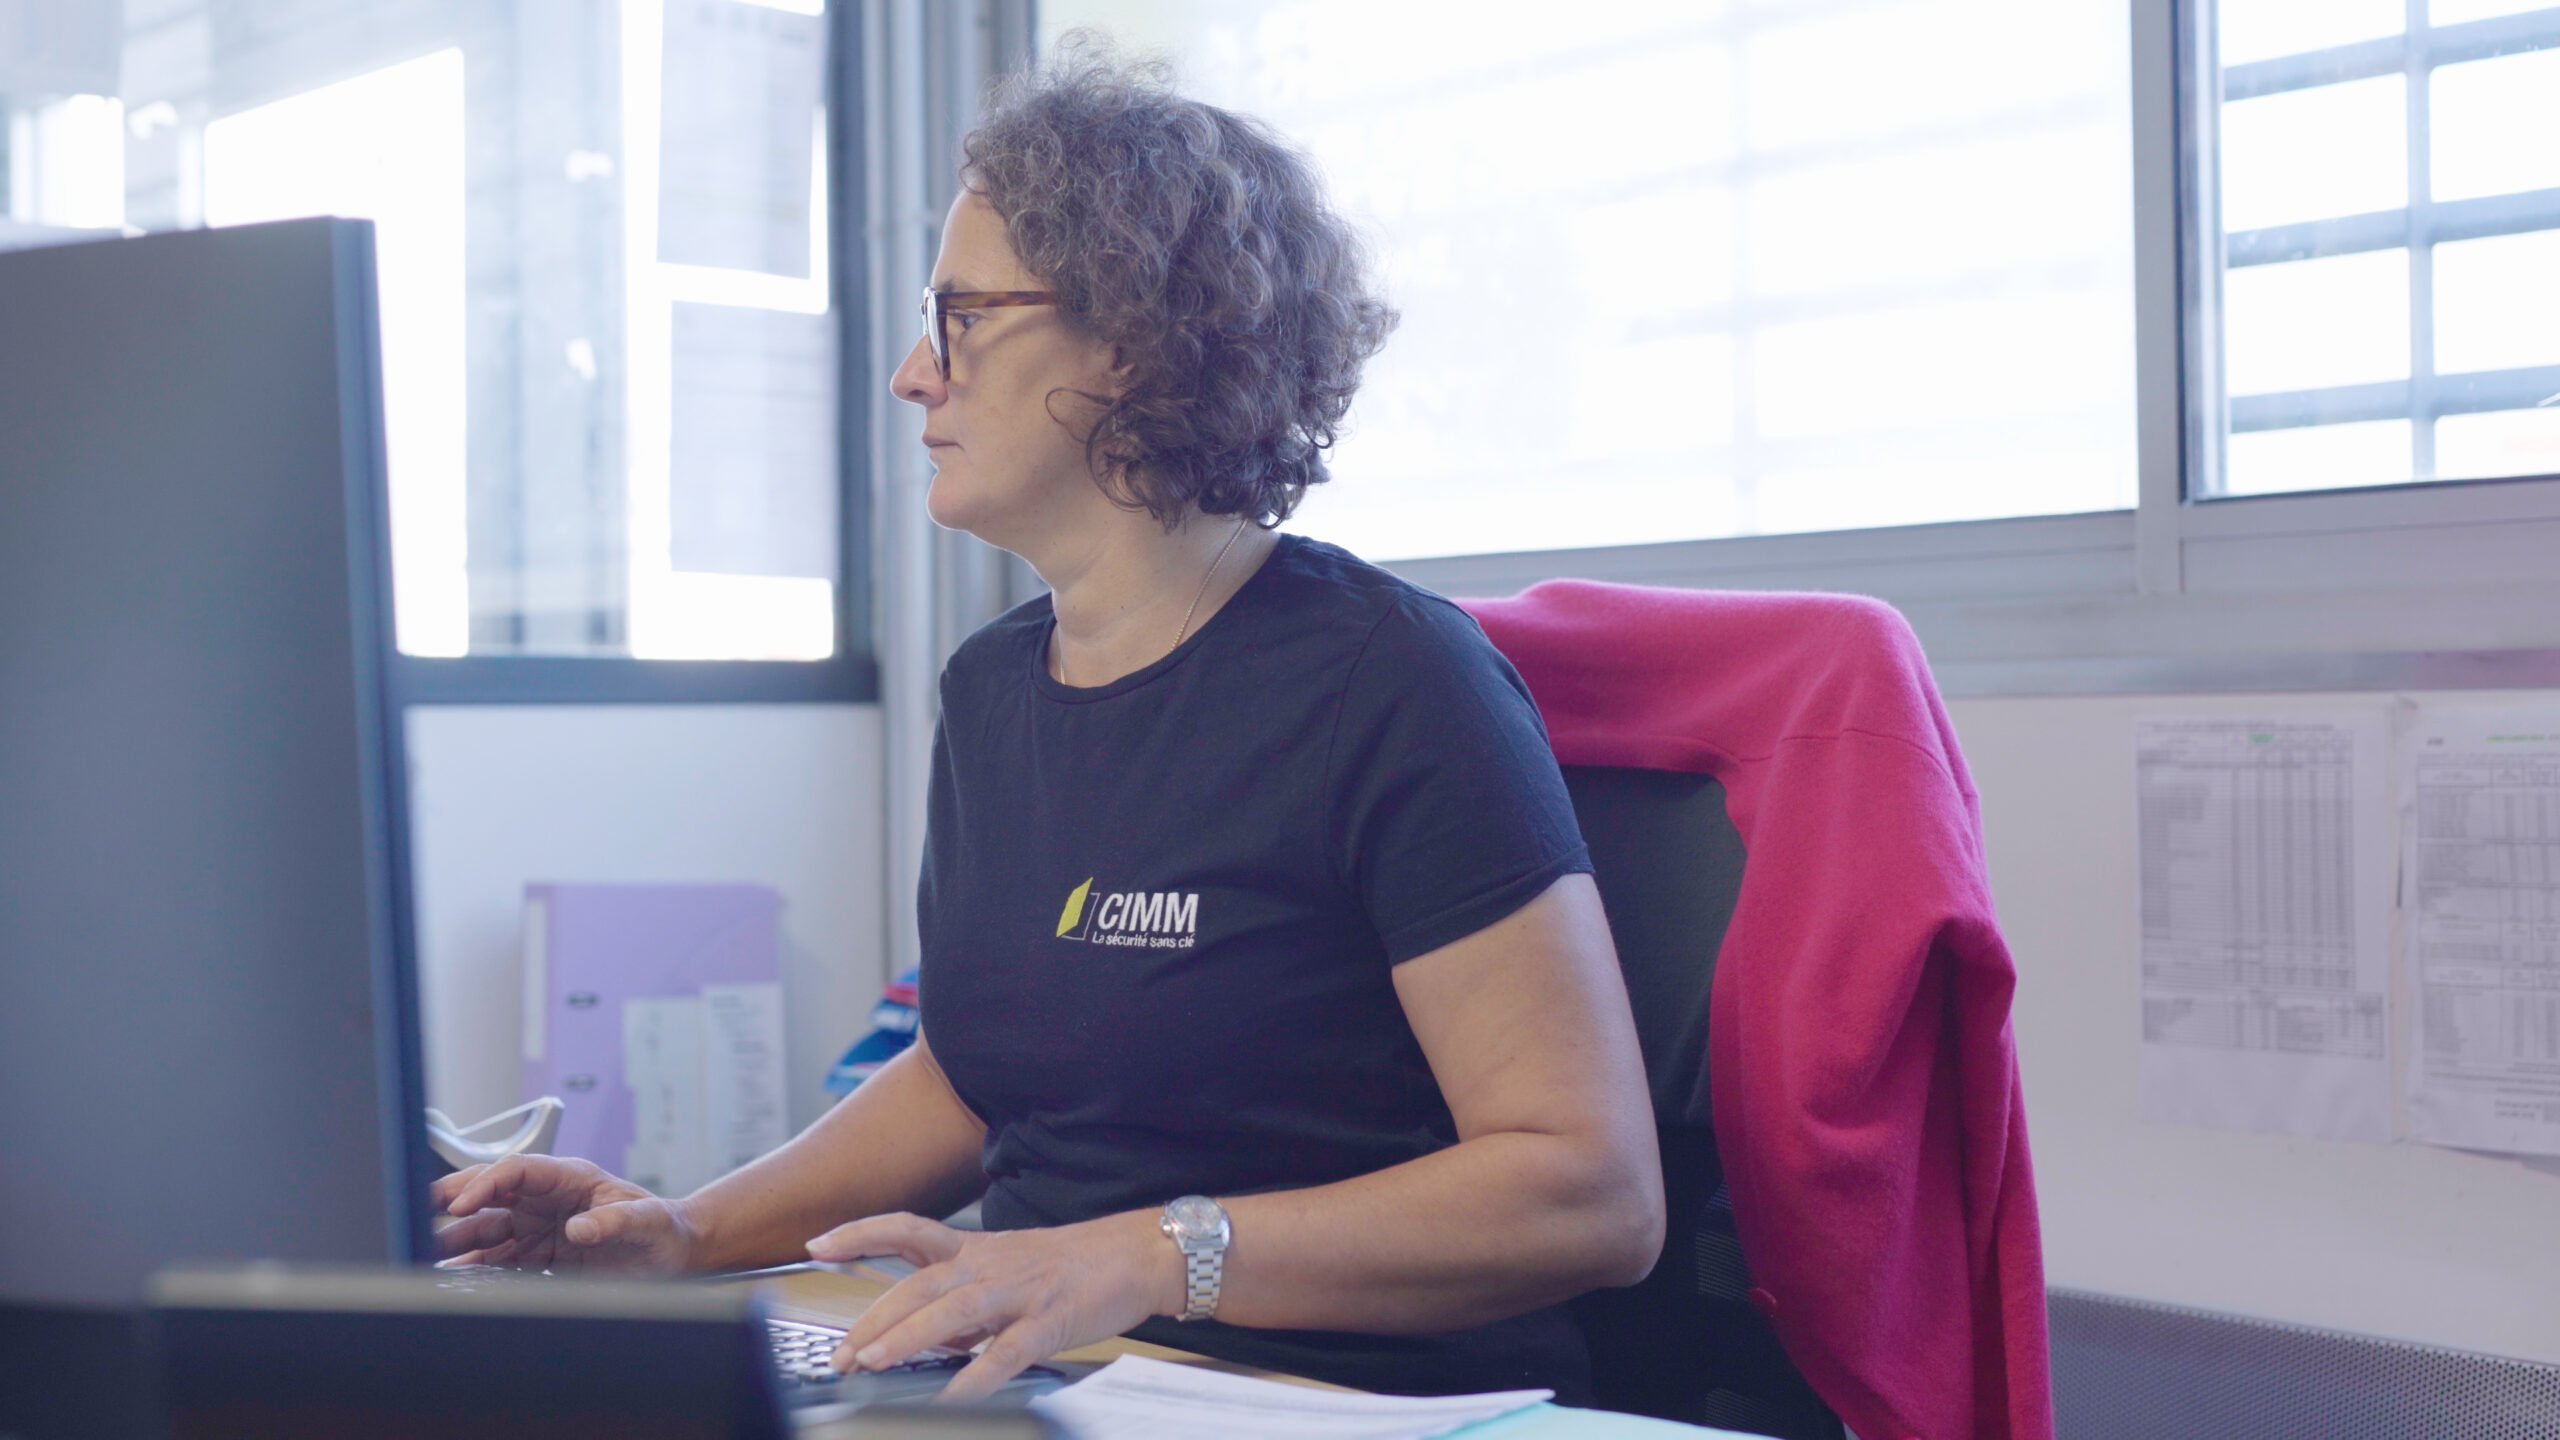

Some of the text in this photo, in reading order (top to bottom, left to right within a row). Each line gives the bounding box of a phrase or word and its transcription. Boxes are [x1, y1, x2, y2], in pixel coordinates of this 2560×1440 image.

[1098, 892, 1199, 933] CIMM
[1092, 930, 1195, 948] La sécurité sans clé
